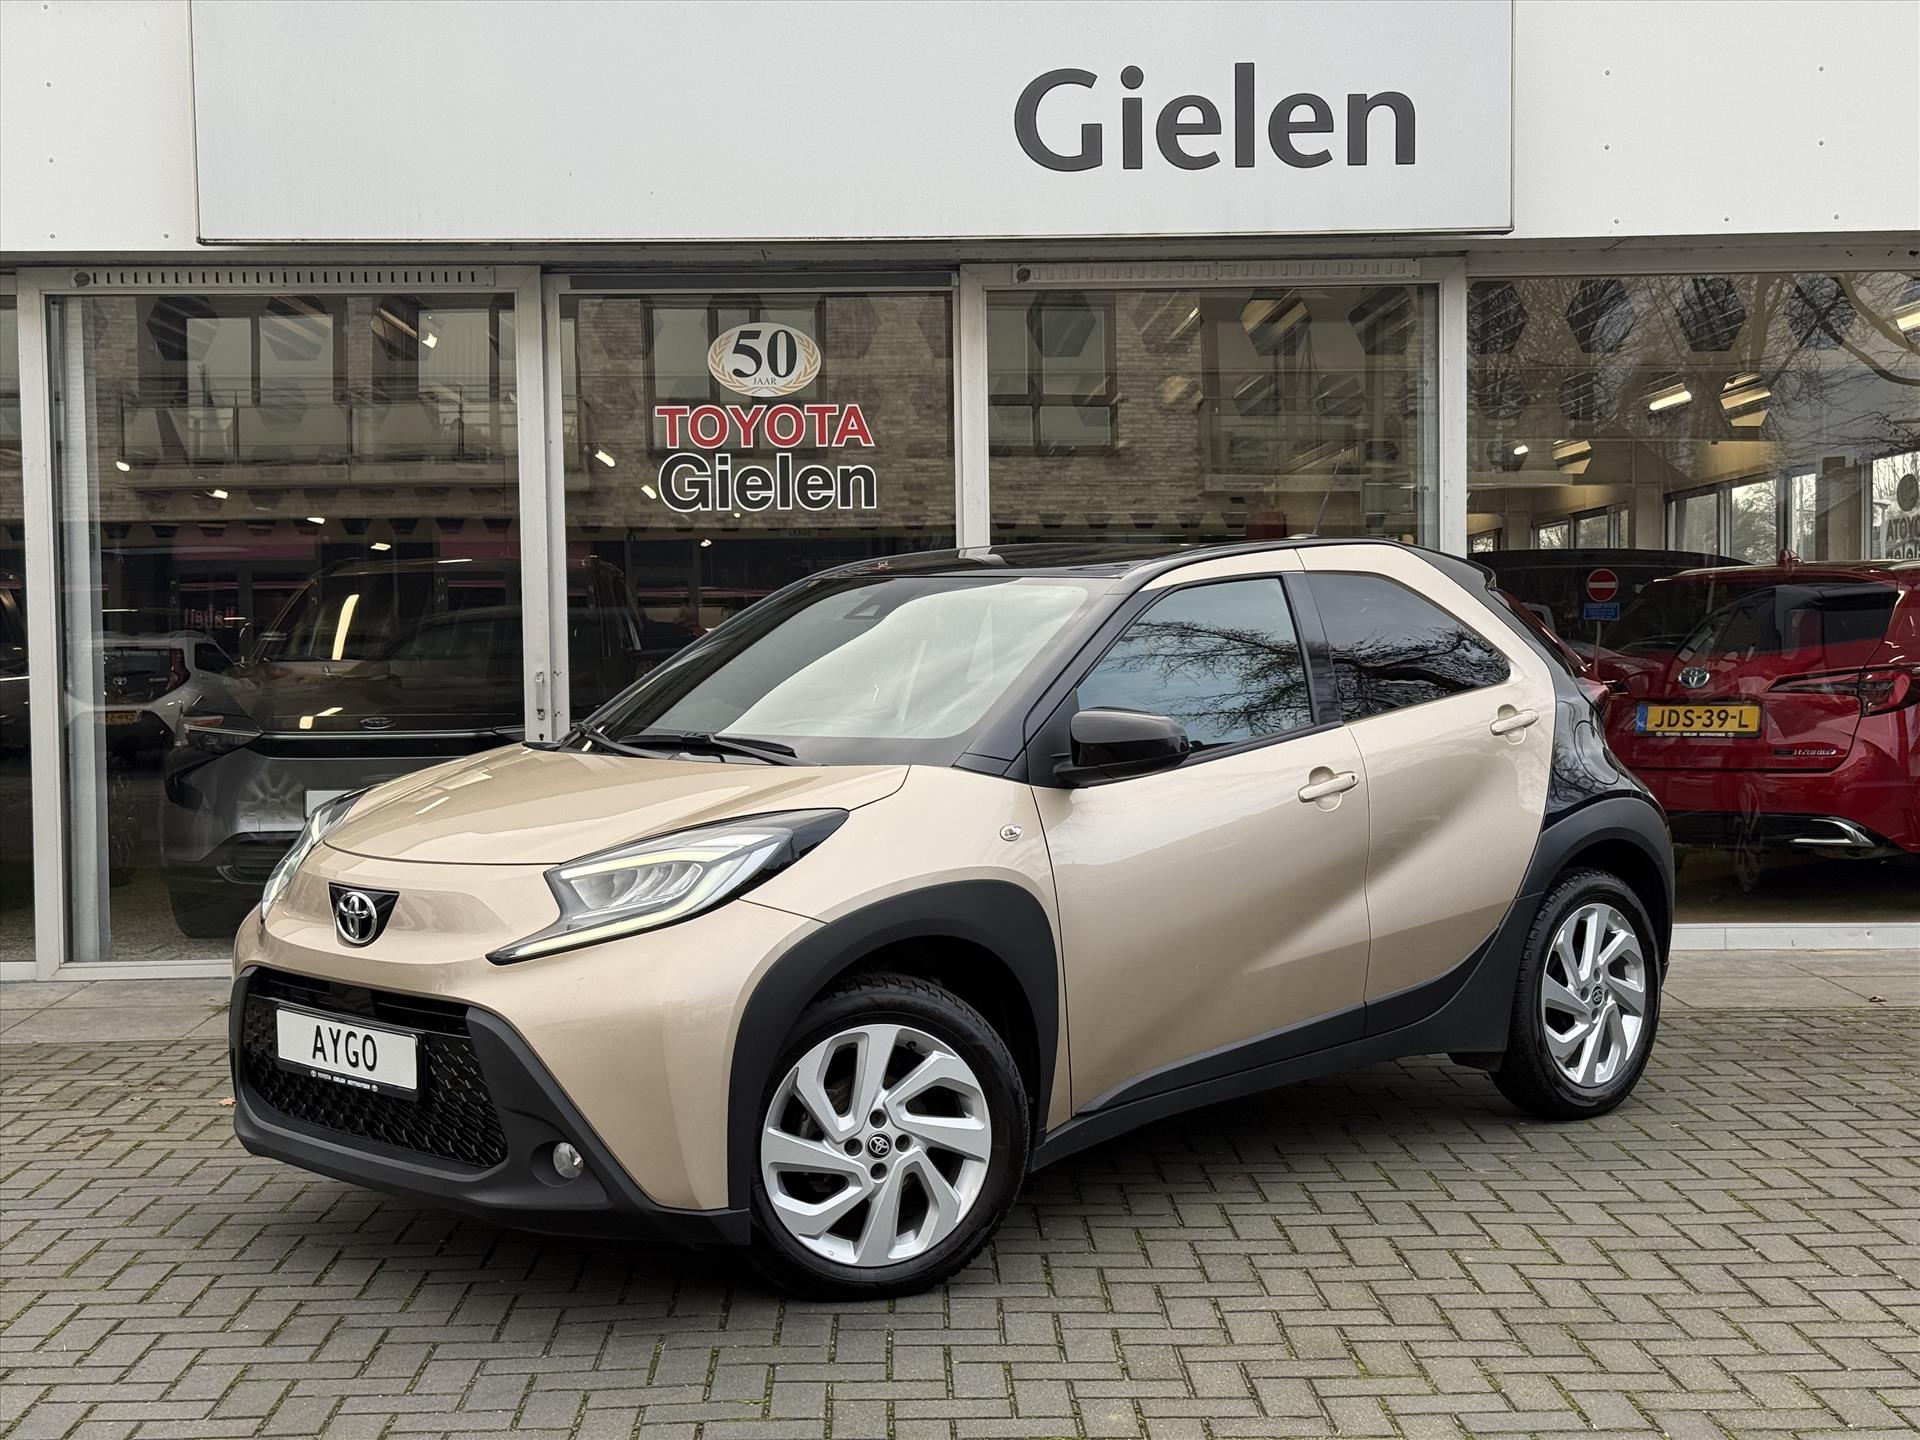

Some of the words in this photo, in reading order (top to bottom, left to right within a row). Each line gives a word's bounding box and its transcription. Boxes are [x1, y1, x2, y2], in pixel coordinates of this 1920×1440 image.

[1013, 62, 1416, 173] Gielen
[732, 329, 798, 378] 50
[752, 377, 777, 386] JAAR
[655, 404, 875, 449] TOYOTA
[658, 452, 877, 512] Gielen
[1654, 709, 1749, 728] JDS-39-L
[312, 1025, 378, 1072] AYGO
